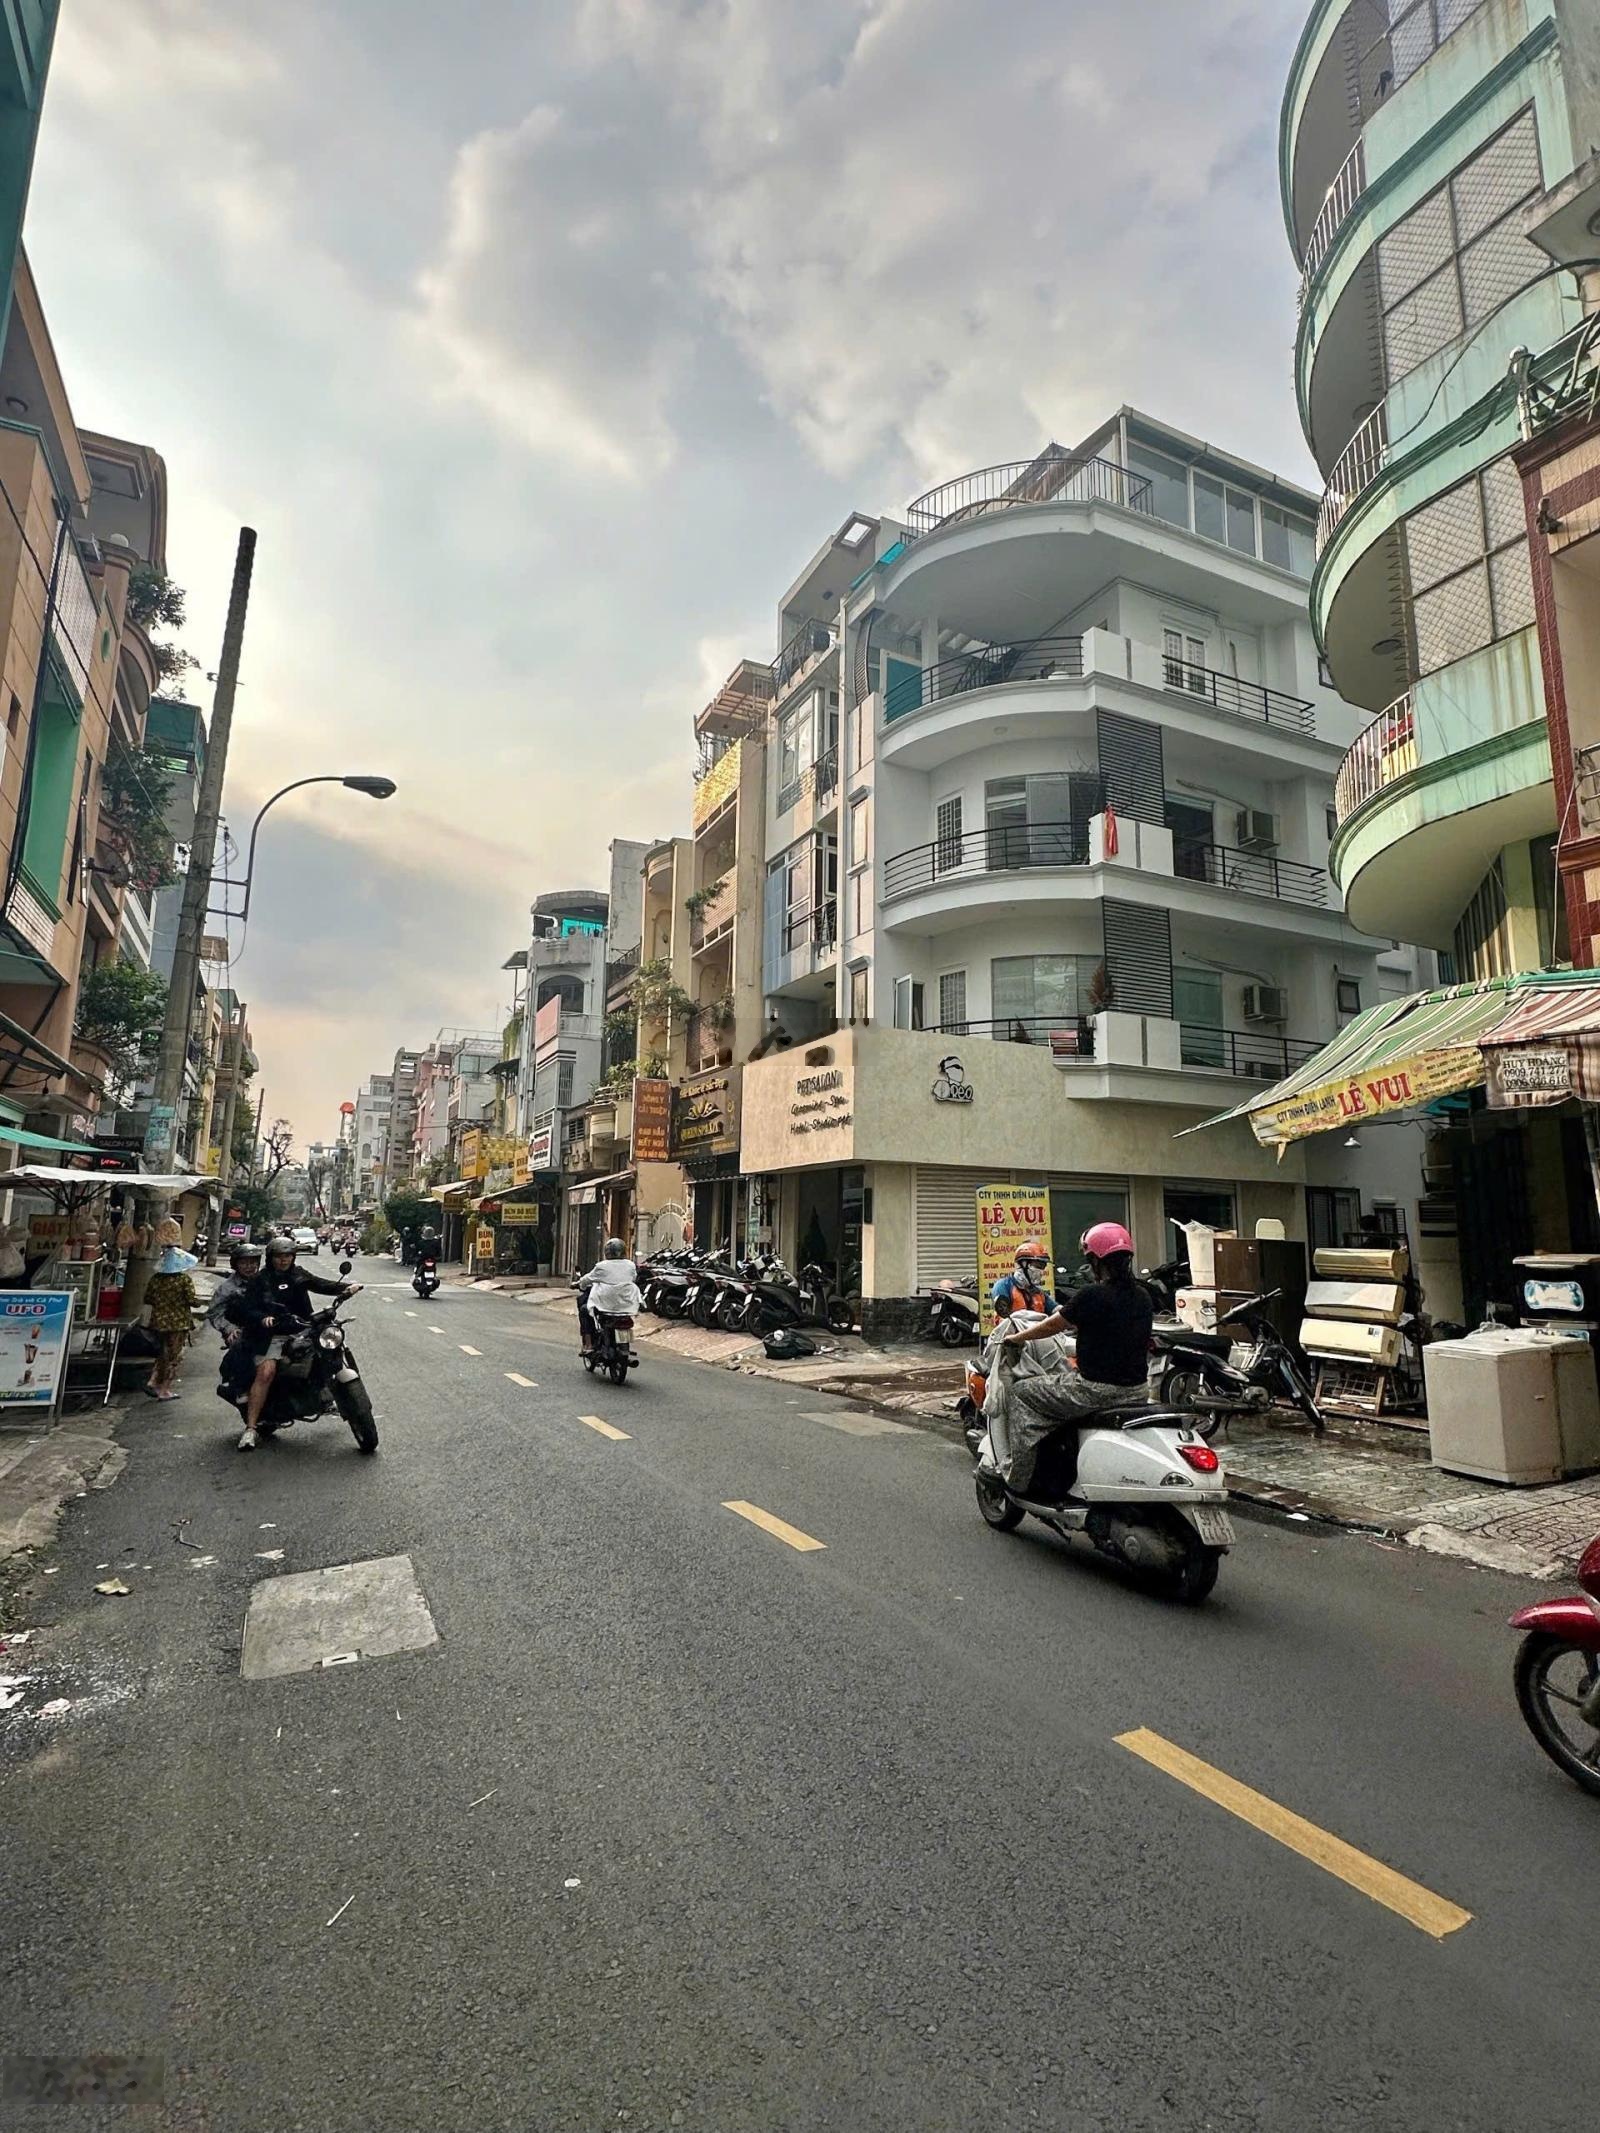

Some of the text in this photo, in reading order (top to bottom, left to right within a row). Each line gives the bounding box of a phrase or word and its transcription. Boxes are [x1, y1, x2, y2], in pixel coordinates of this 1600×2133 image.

[1503, 1060, 1524, 1069] HUY
[1337, 1081, 1367, 1116] LÊ
[1367, 1073, 1412, 1108] VUI
[979, 1190, 991, 1200] CTY
[993, 1190, 1011, 1200] TNHH
[981, 1202, 1045, 1224] LÊ VUI
[5, 1303, 47, 1316] UFO
